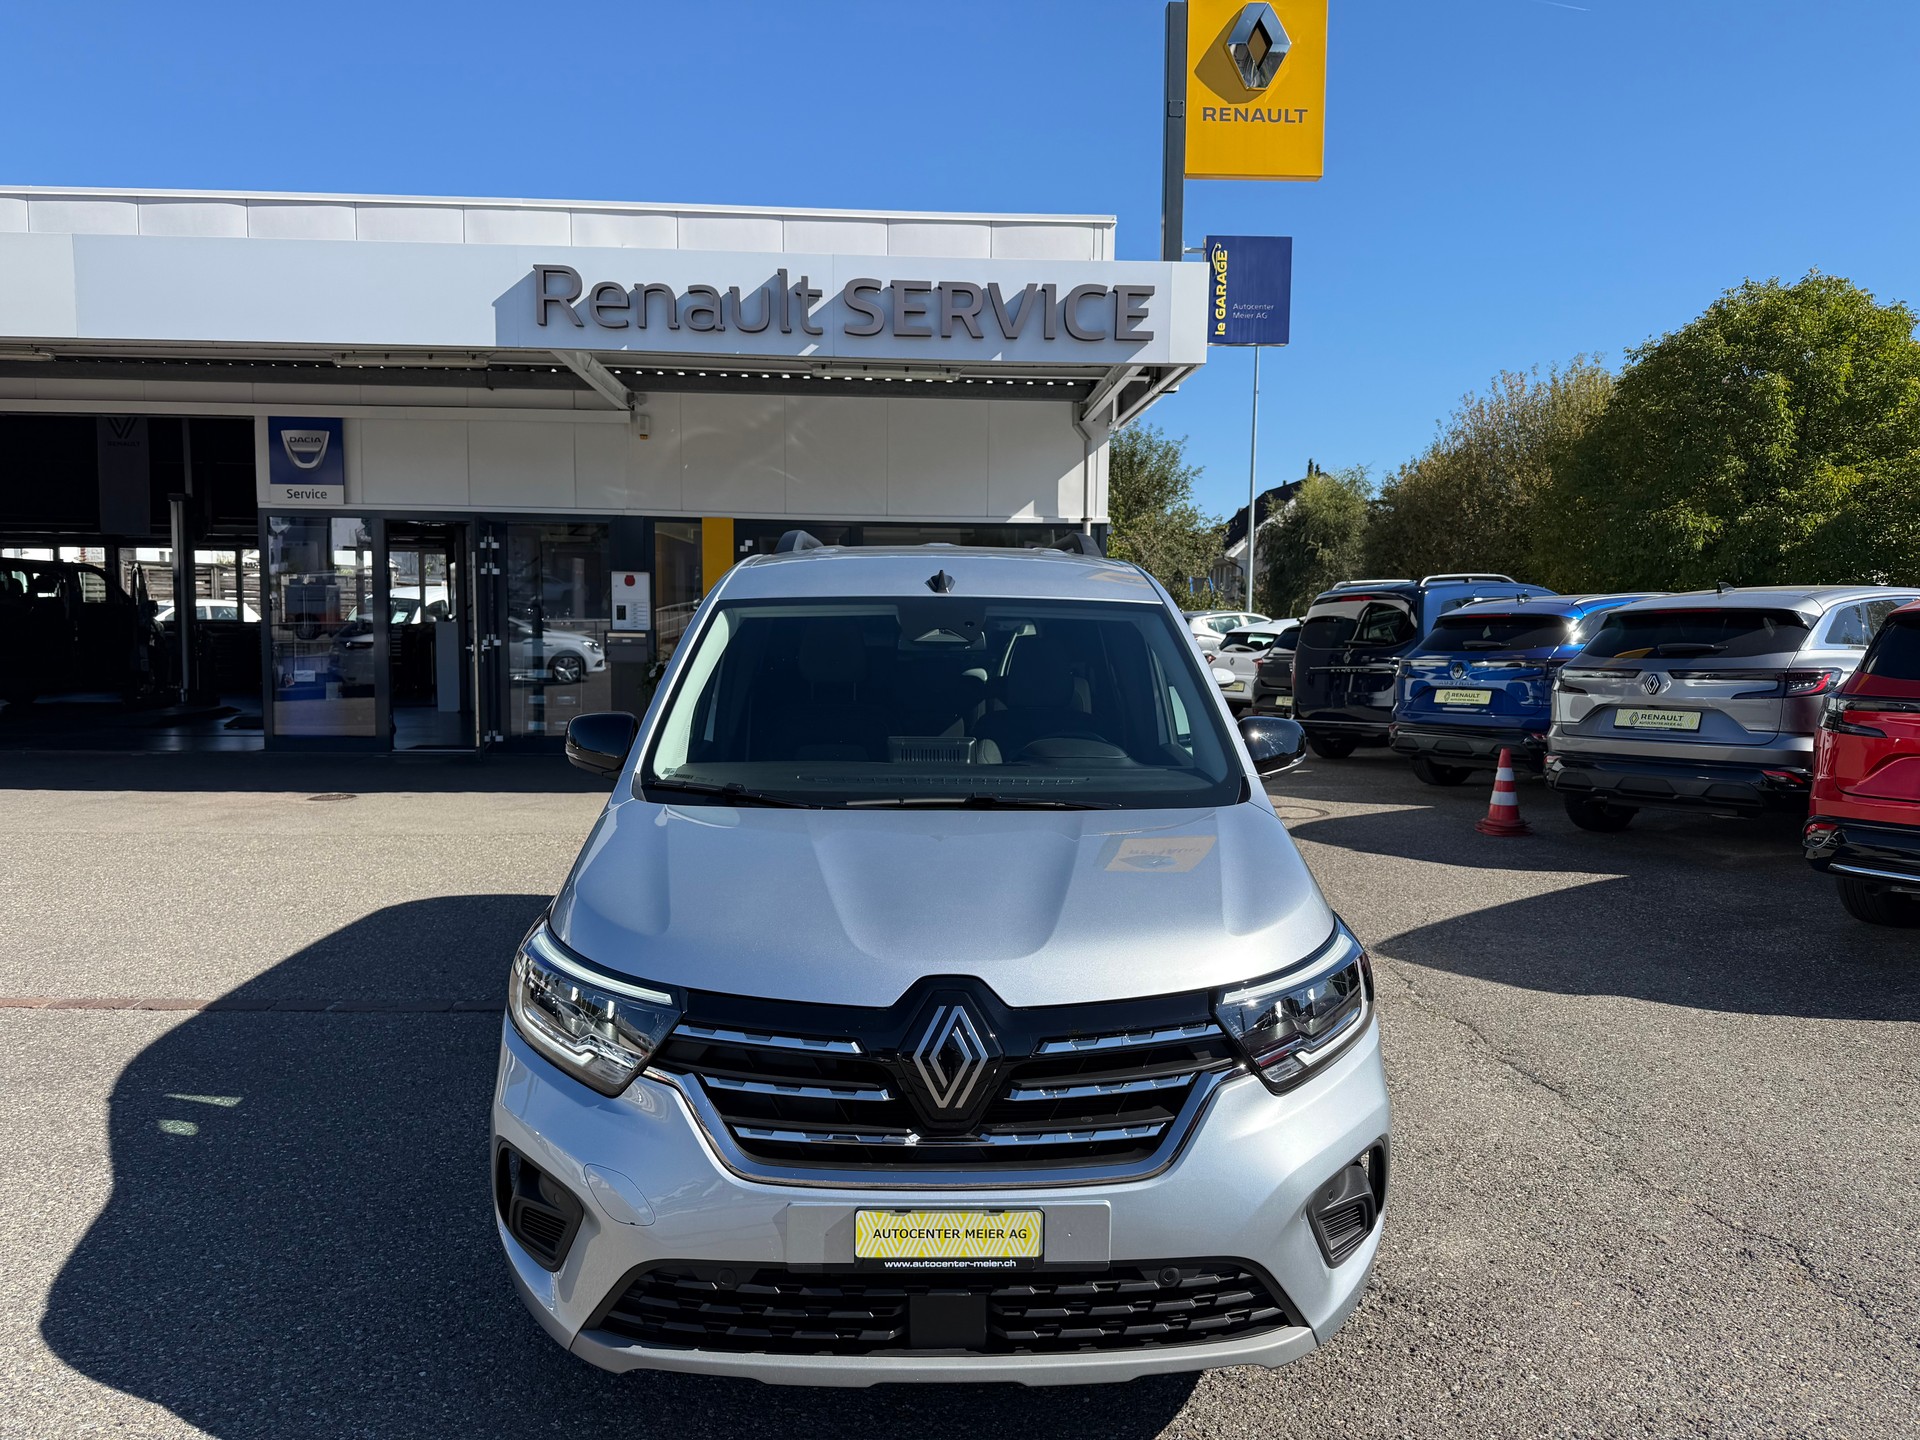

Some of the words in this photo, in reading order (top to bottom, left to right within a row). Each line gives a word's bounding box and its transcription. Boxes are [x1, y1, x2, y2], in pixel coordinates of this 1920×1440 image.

[1202, 106, 1308, 124] RENAULT
[1215, 249, 1228, 320] GARAGE
[533, 264, 823, 335] Renault
[843, 277, 1156, 342] SERVICE
[1214, 322, 1226, 336] le
[286, 488, 328, 499] Service
[872, 1228, 960, 1240] AUTOCENTER
[965, 1228, 1004, 1240] MEIER
[1008, 1228, 1027, 1240] AG
[884, 1259, 1017, 1269] www.autocenter-meier.ch
